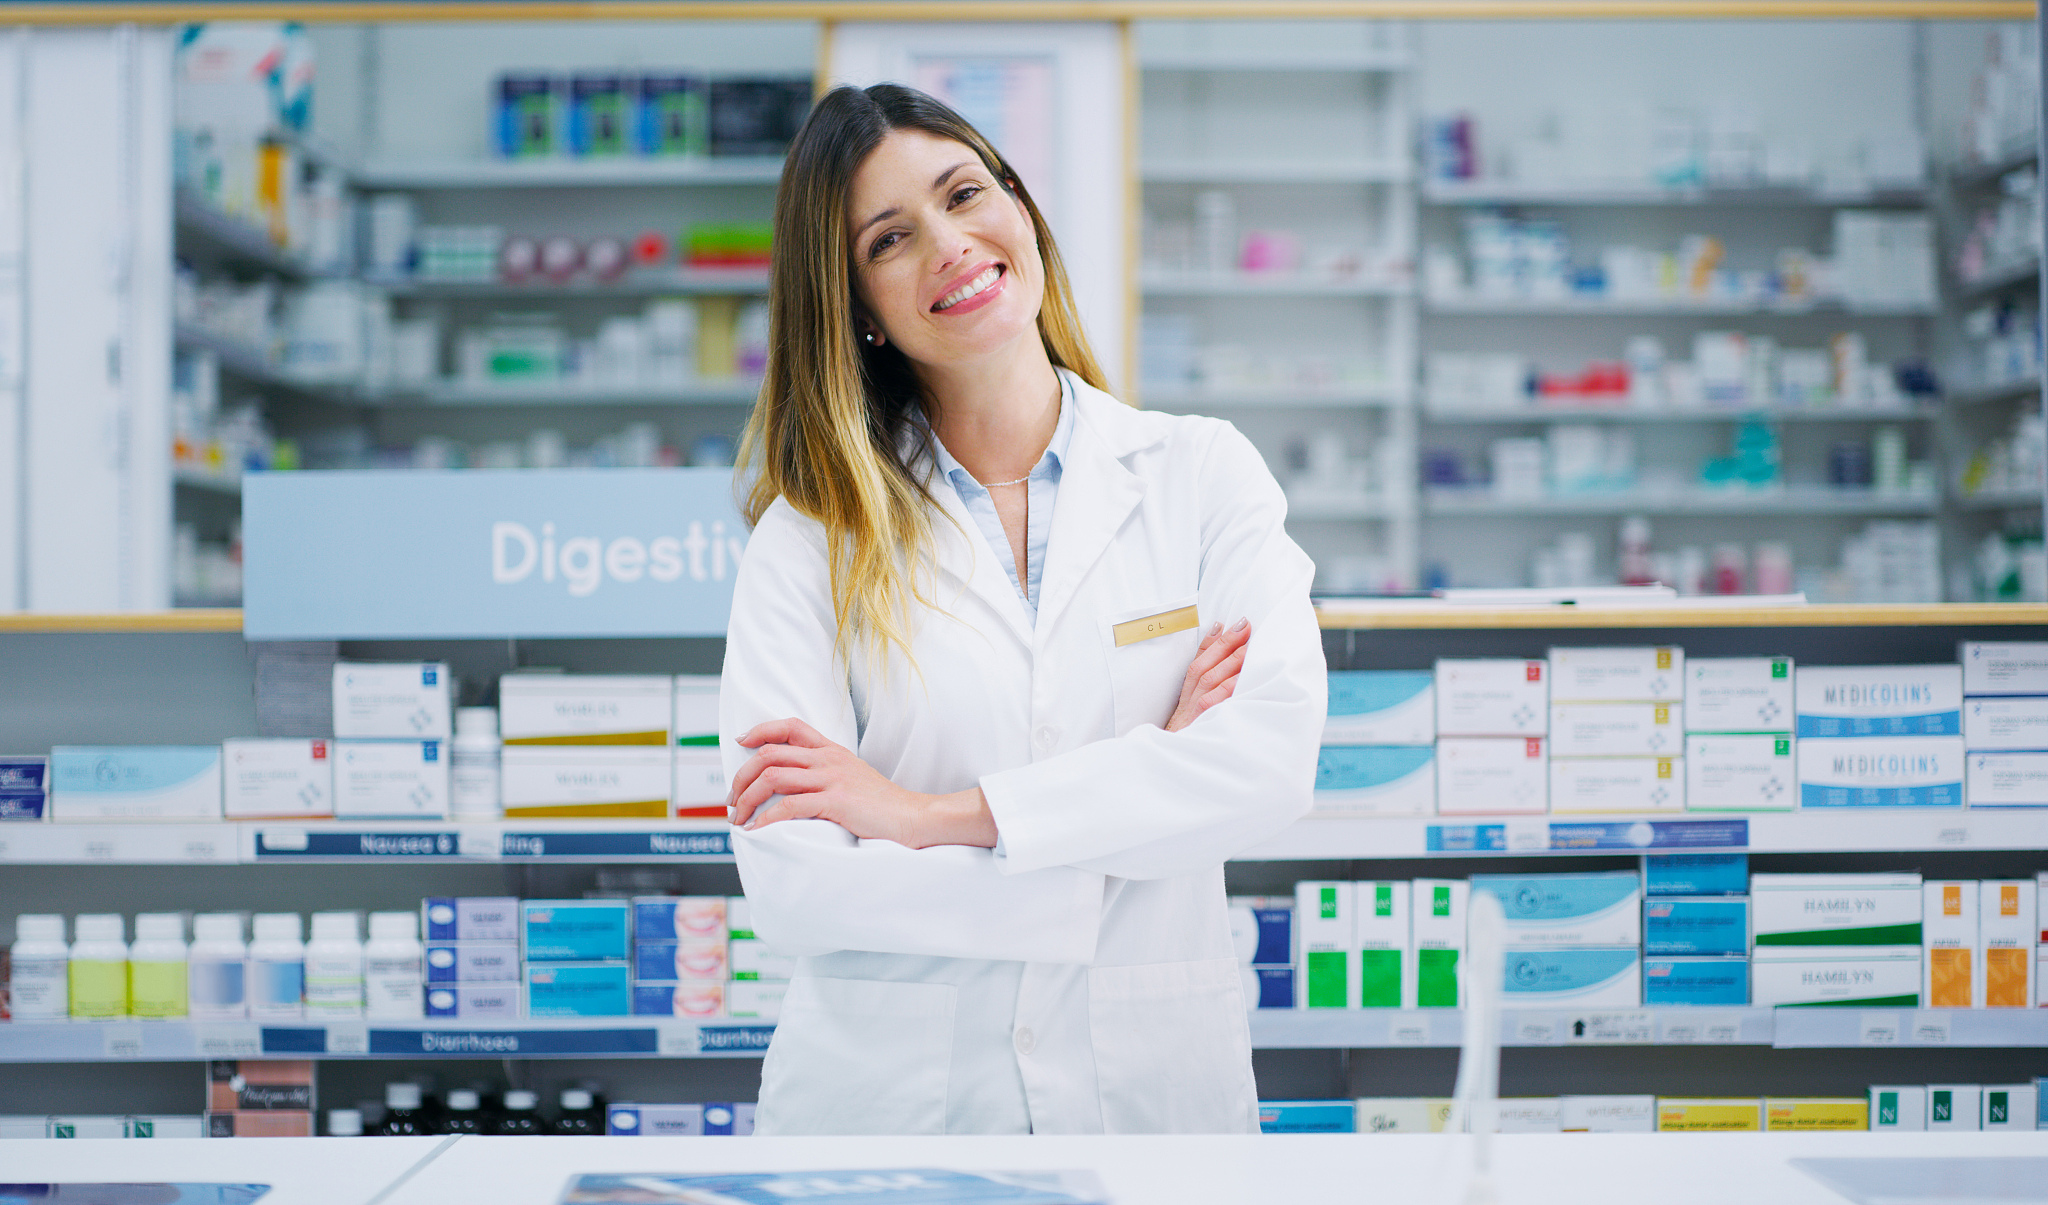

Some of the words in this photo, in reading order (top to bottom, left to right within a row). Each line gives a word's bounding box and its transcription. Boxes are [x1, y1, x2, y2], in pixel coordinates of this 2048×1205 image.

[1824, 682, 1932, 706] MEDICOLINS
[1833, 754, 1939, 777] MEDICOLINS
[360, 834, 434, 854] Nausea
[650, 833, 725, 854] Nausea
[1804, 898, 1876, 914] HAMILYN
[1802, 970, 1874, 985] HAMILYN
[422, 1031, 519, 1051] Diarrhoea
